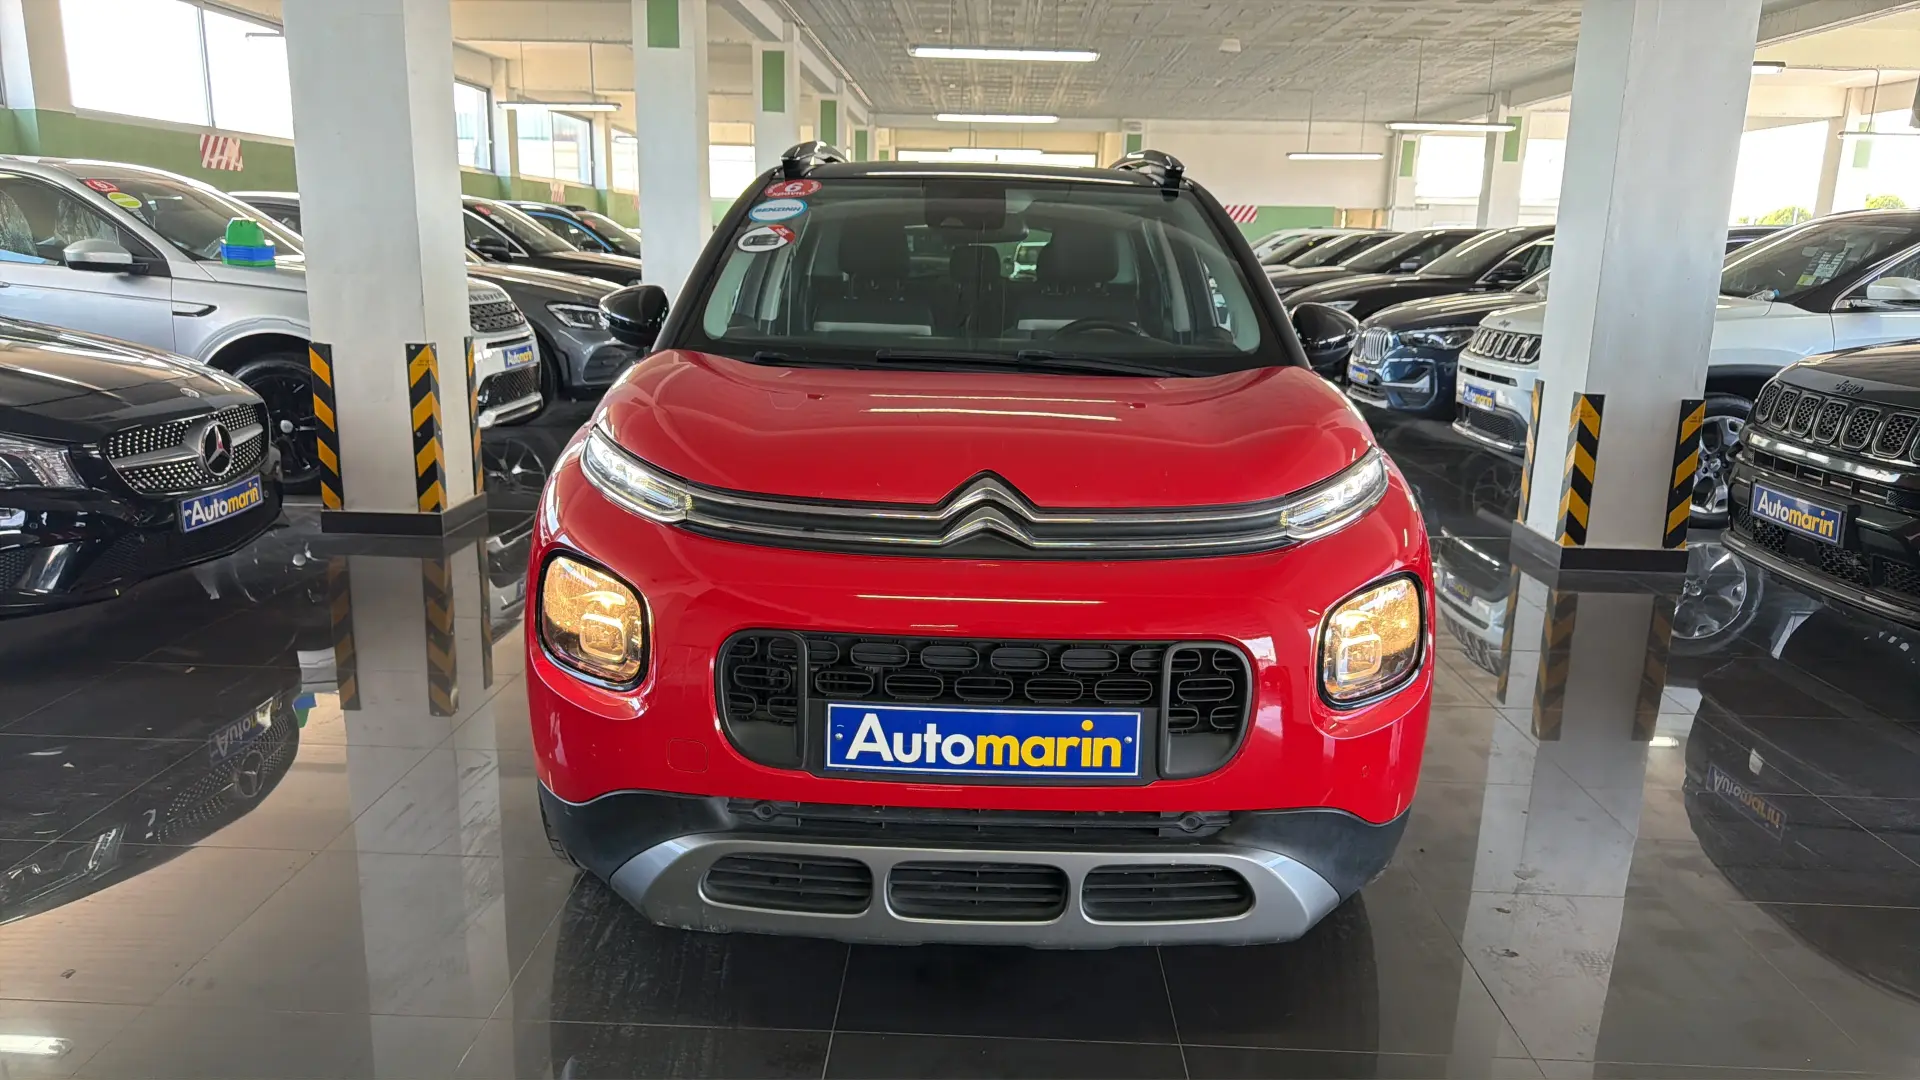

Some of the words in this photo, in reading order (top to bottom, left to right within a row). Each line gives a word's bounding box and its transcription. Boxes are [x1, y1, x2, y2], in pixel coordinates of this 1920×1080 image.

[784, 182, 804, 193] 6
[191, 481, 259, 526] Automarin
[1757, 490, 1835, 537] Automarin
[845, 712, 1122, 768] Automarin
